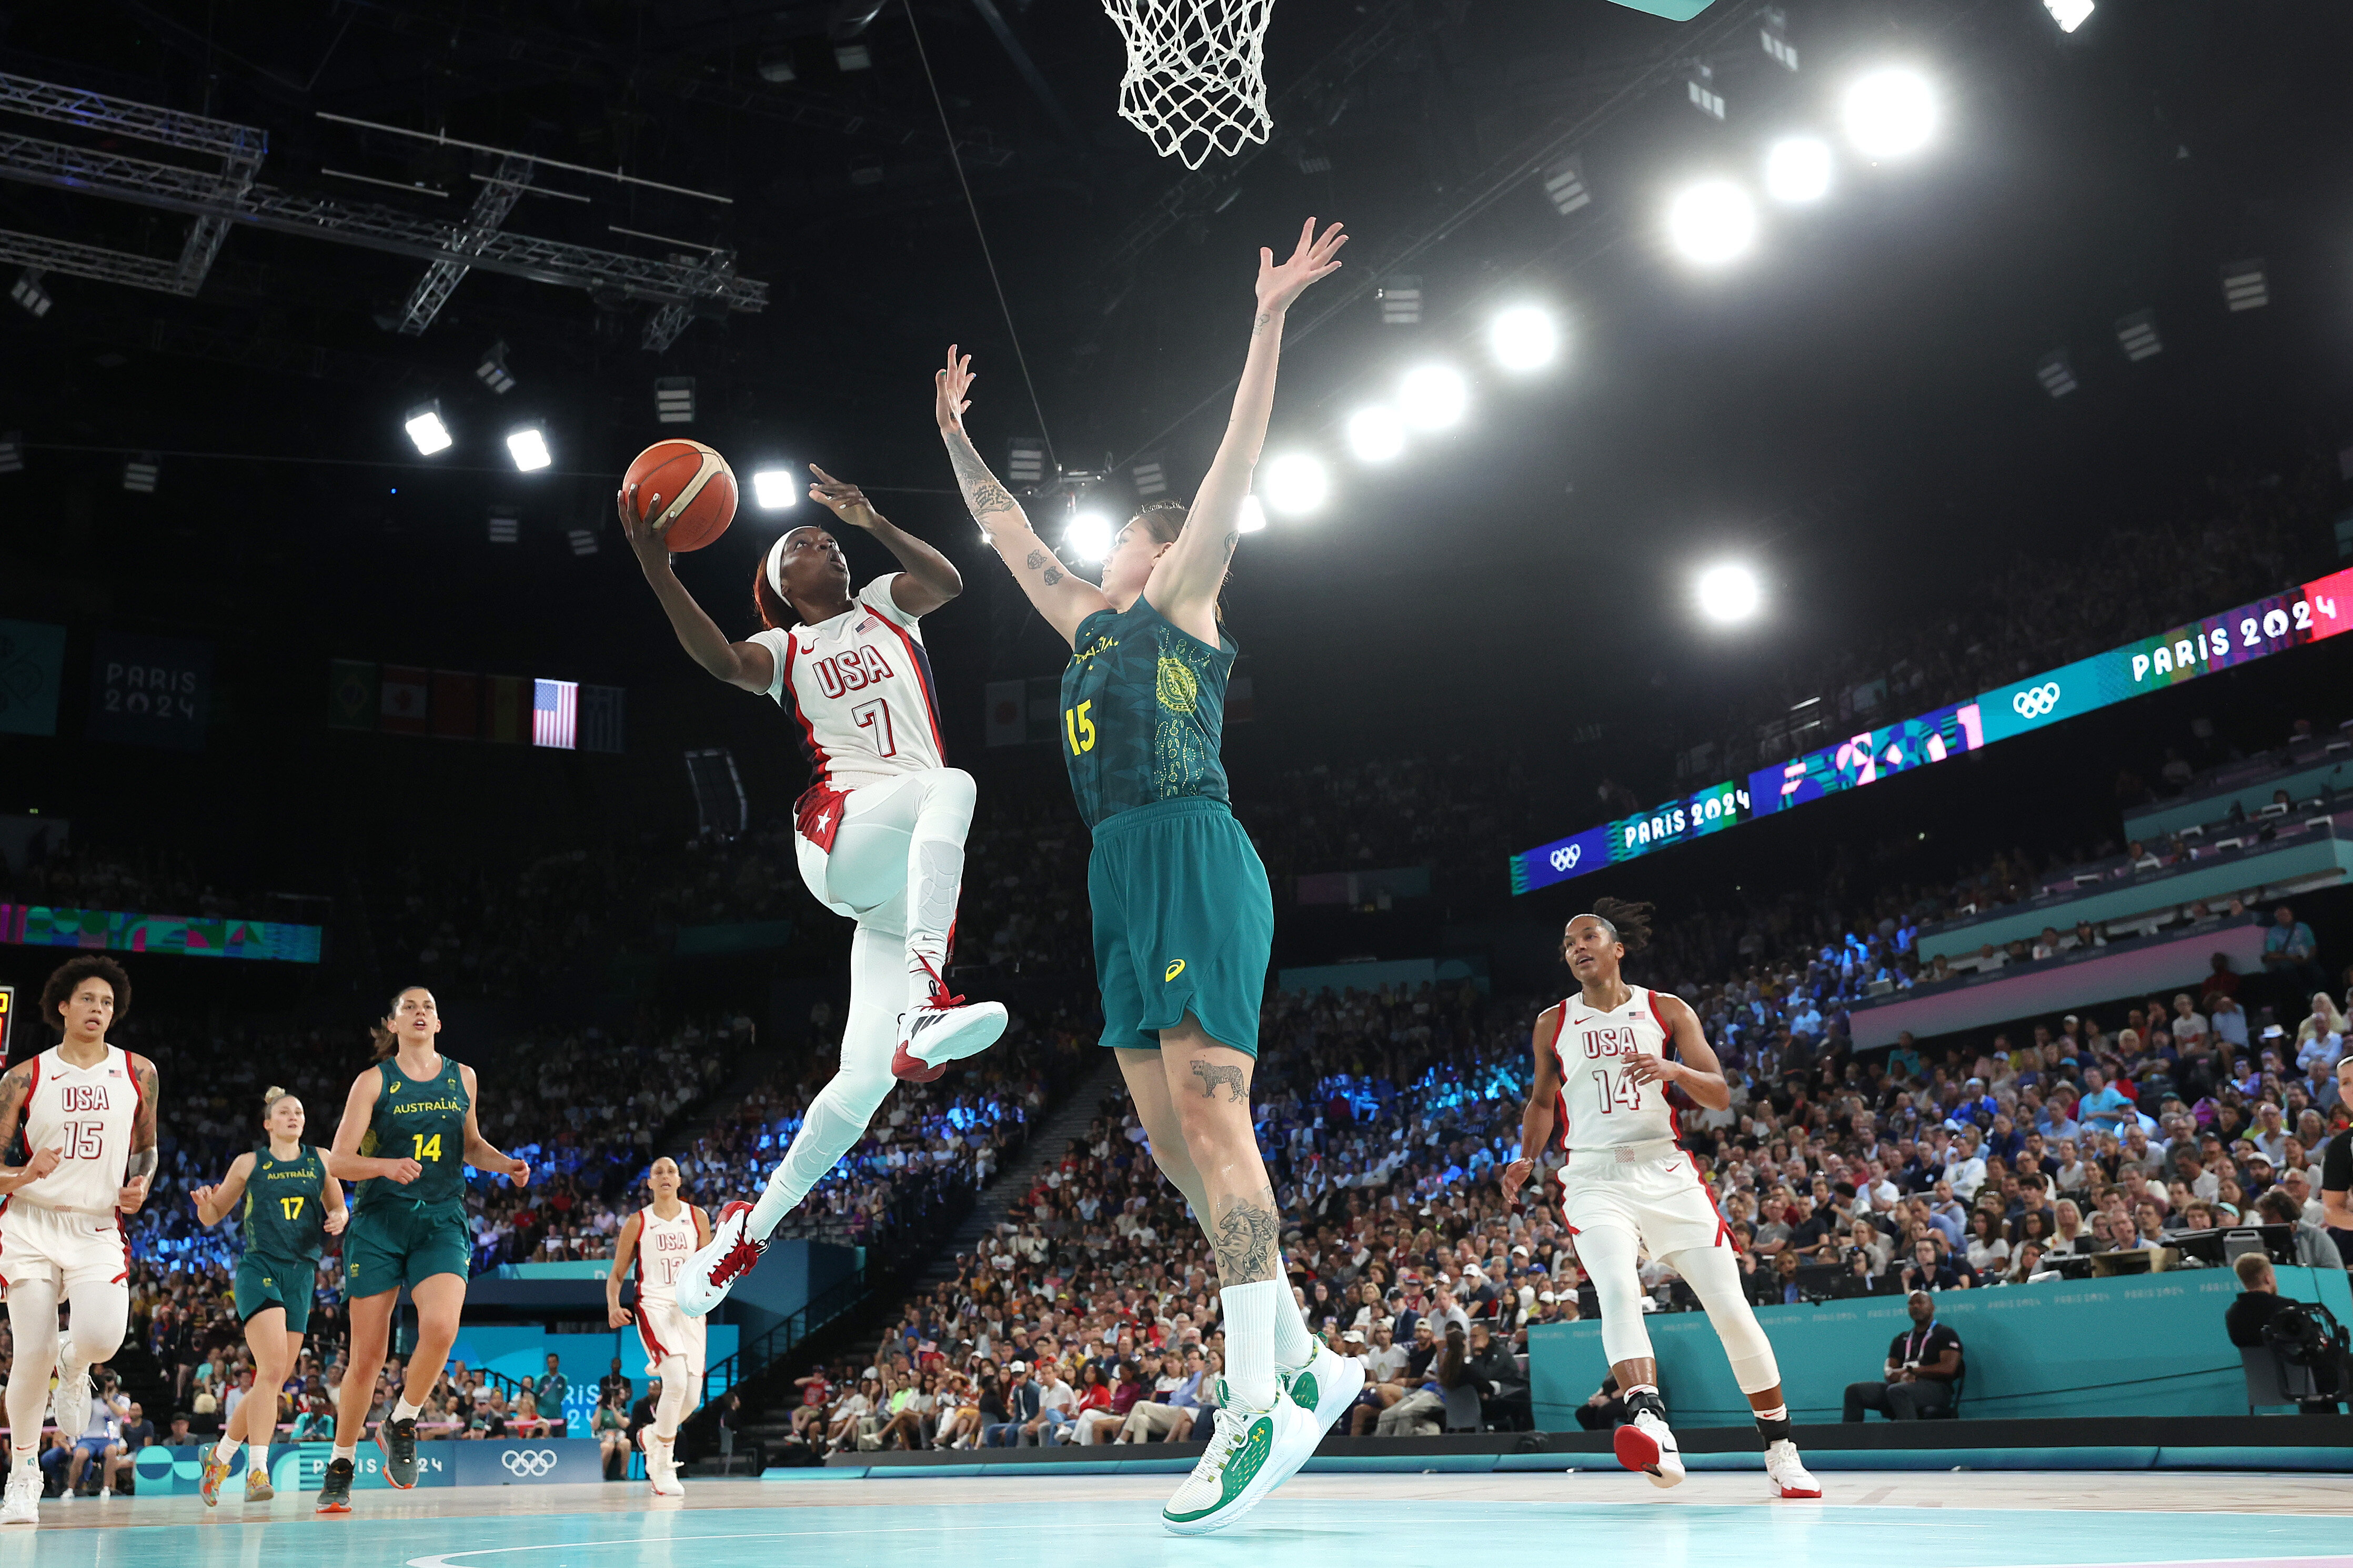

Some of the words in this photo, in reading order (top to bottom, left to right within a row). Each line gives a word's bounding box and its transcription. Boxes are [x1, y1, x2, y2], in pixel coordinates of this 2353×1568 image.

[2132, 628, 2230, 682] PARIS
[2240, 595, 2336, 647] 2024
[107, 663, 195, 693] PARIS
[813, 644, 894, 699] USA
[105, 689, 193, 720] 2024
[851, 698, 896, 757] 7
[1066, 699, 1095, 756] 15
[1625, 810, 1685, 848] PARIS
[1691, 789, 1750, 825] 2024
[1582, 1027, 1637, 1059] USA
[62, 1086, 109, 1111] USA
[1592, 1067, 1641, 1114] 14
[393, 1099, 458, 1114] AUSTRALIA
[64, 1121, 103, 1159] 15
[412, 1134, 441, 1162] 14
[267, 1169, 316, 1179] AUSTRALIA
[280, 1196, 304, 1220] 17
[656, 1232, 687, 1251] USA
[1231, 1458, 1241, 1471] UNDER
[1240, 1442, 1253, 1459] ARMOUR
